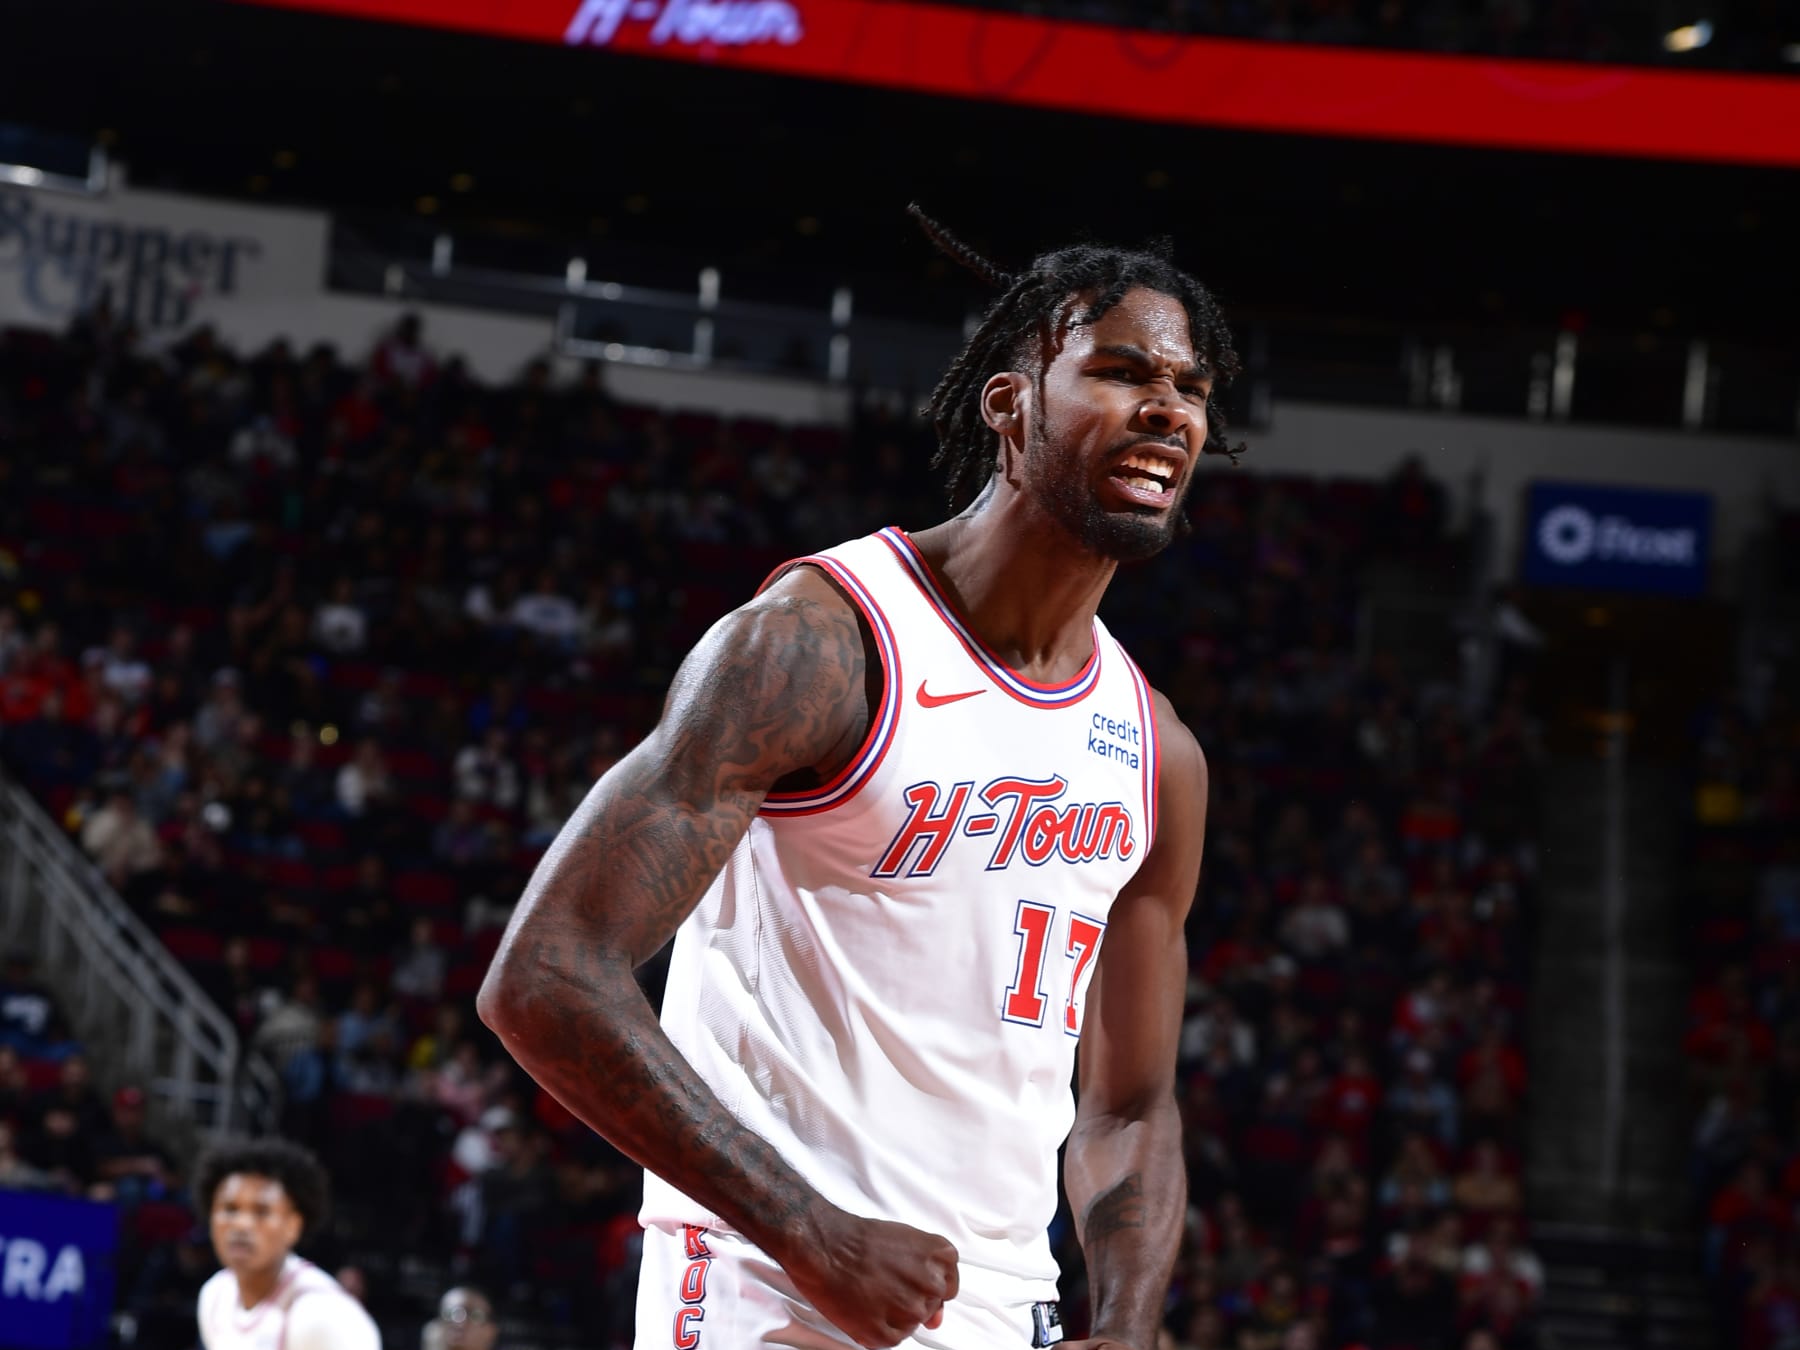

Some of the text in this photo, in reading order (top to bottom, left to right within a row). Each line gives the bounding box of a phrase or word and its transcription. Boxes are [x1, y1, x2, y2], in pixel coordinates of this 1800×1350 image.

[1087, 728, 1139, 770] karma
[1092, 712, 1140, 746] credit
[869, 774, 1136, 878] H-Town
[1001, 899, 1108, 1037] 17
[0, 1233, 86, 1303] RA
